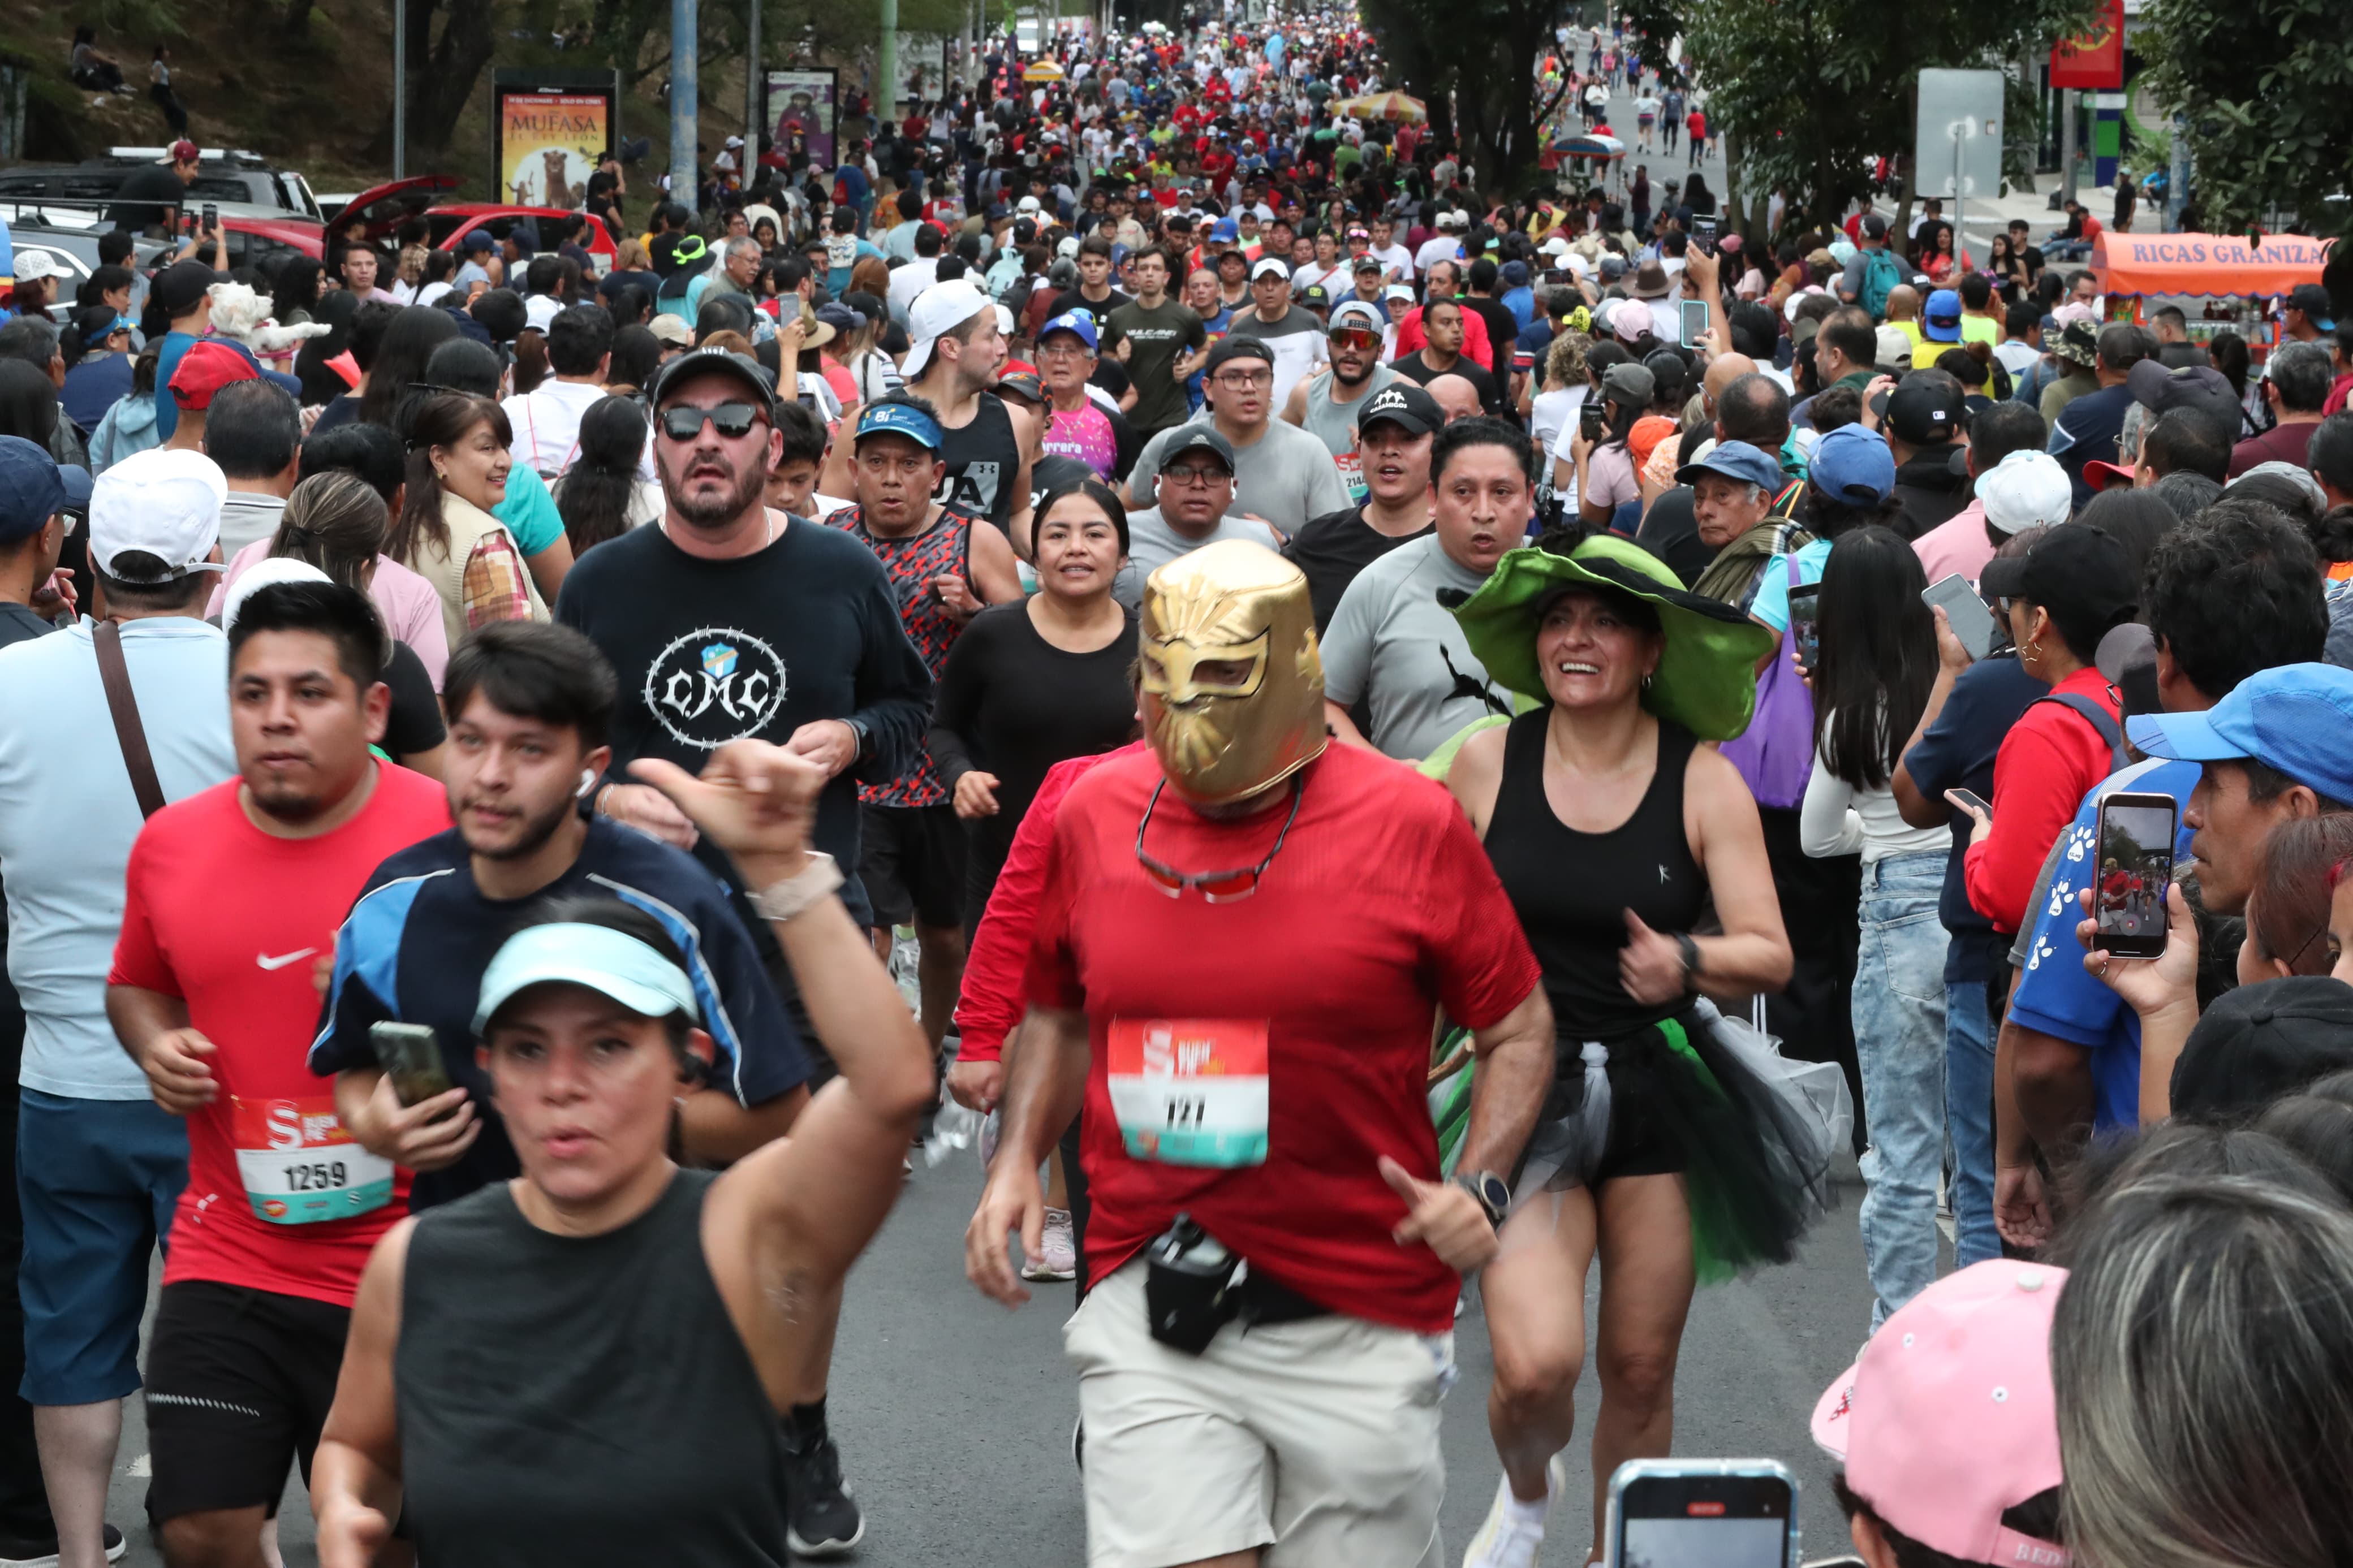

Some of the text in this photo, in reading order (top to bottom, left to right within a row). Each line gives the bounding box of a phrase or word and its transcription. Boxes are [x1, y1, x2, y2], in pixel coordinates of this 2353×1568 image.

[511, 115, 597, 132] MUFASA
[2132, 244, 2207, 263] RICAS
[285, 1161, 346, 1191] 1259
